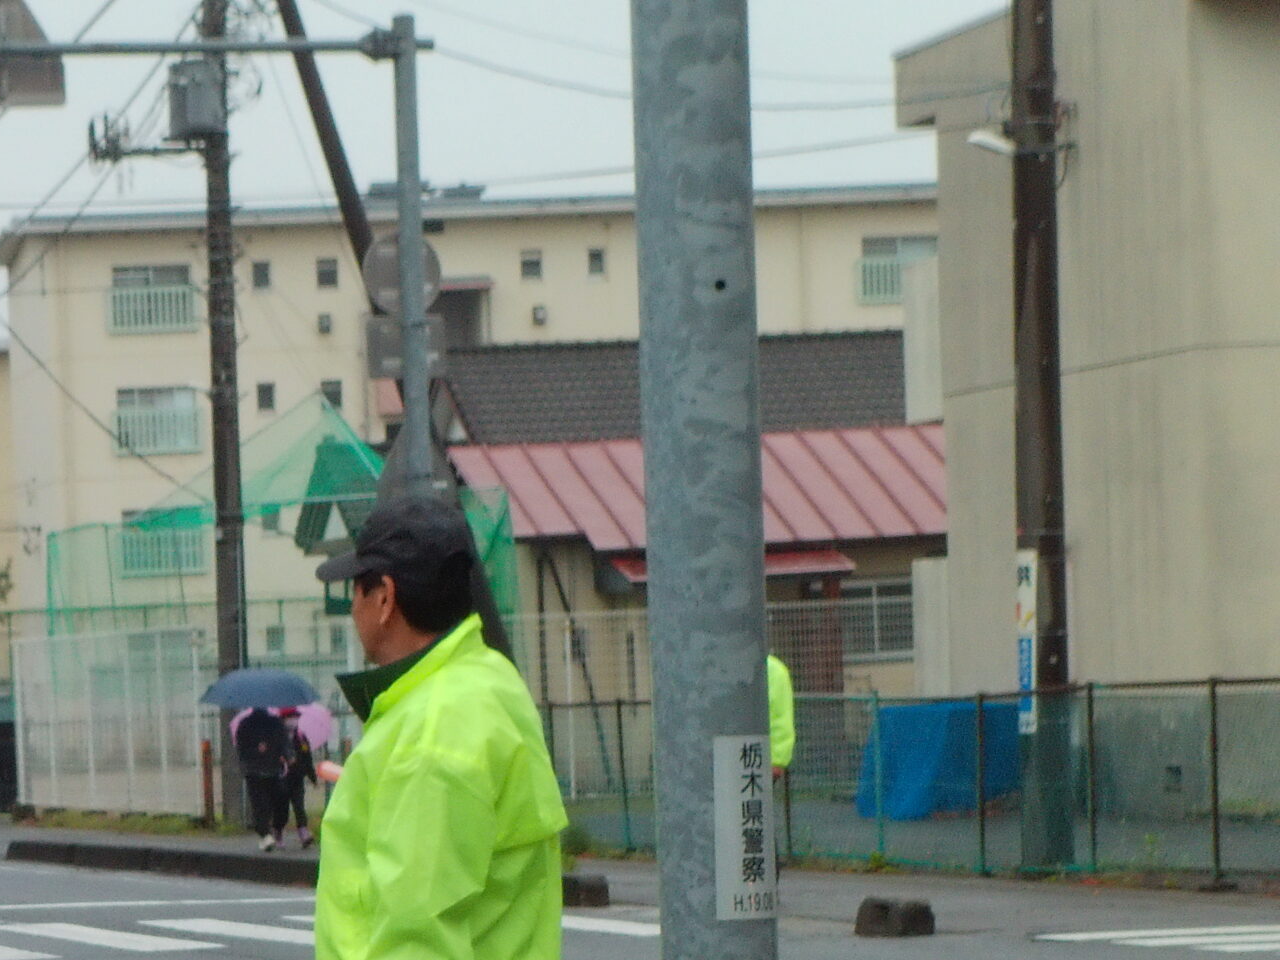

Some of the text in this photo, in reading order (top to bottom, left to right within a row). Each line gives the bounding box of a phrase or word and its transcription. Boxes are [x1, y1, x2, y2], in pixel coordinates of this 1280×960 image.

[740, 742, 765, 883] 栃木県警察
